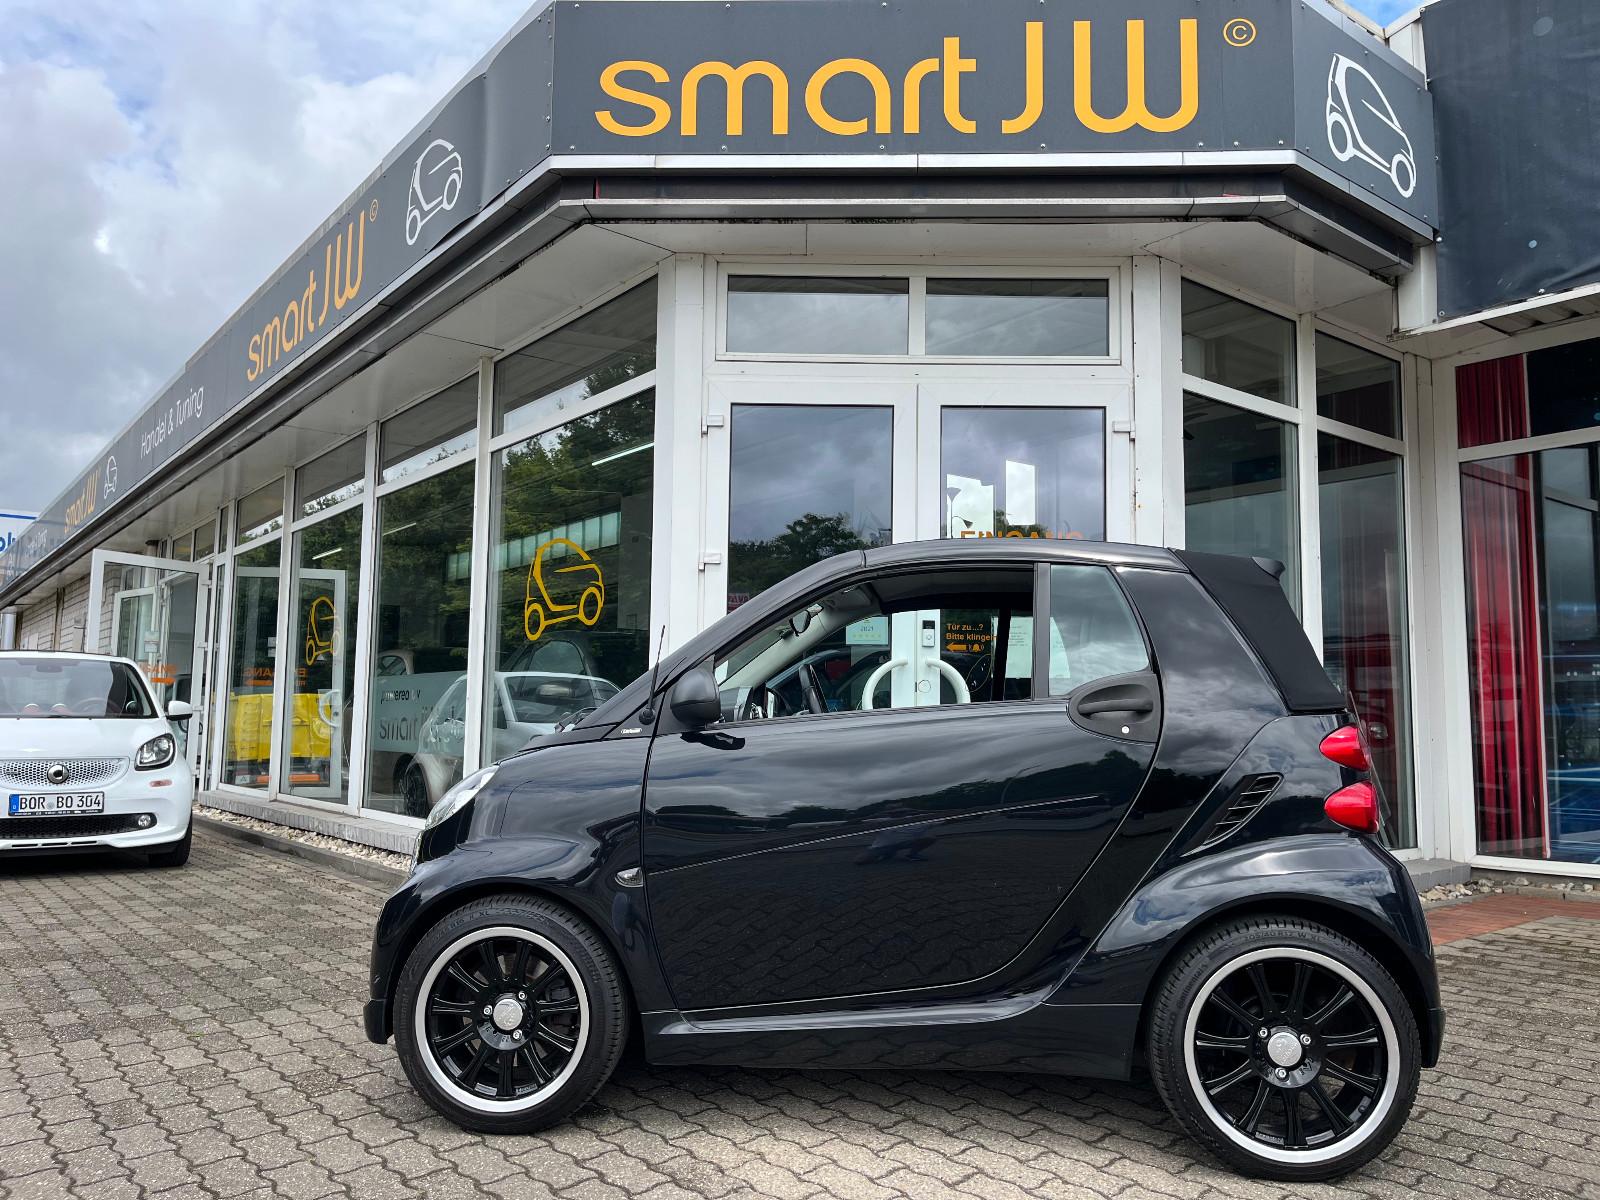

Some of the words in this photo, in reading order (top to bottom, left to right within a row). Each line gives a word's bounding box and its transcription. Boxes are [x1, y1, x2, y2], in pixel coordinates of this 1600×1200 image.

[595, 36, 977, 137] smart
[246, 269, 317, 382] smart
[140, 413, 168, 460] Handel
[167, 407, 174, 435] &
[175, 386, 204, 428] Tuning
[19, 796, 46, 810] BOR
[56, 795, 74, 809] BO
[76, 794, 101, 808] 304
